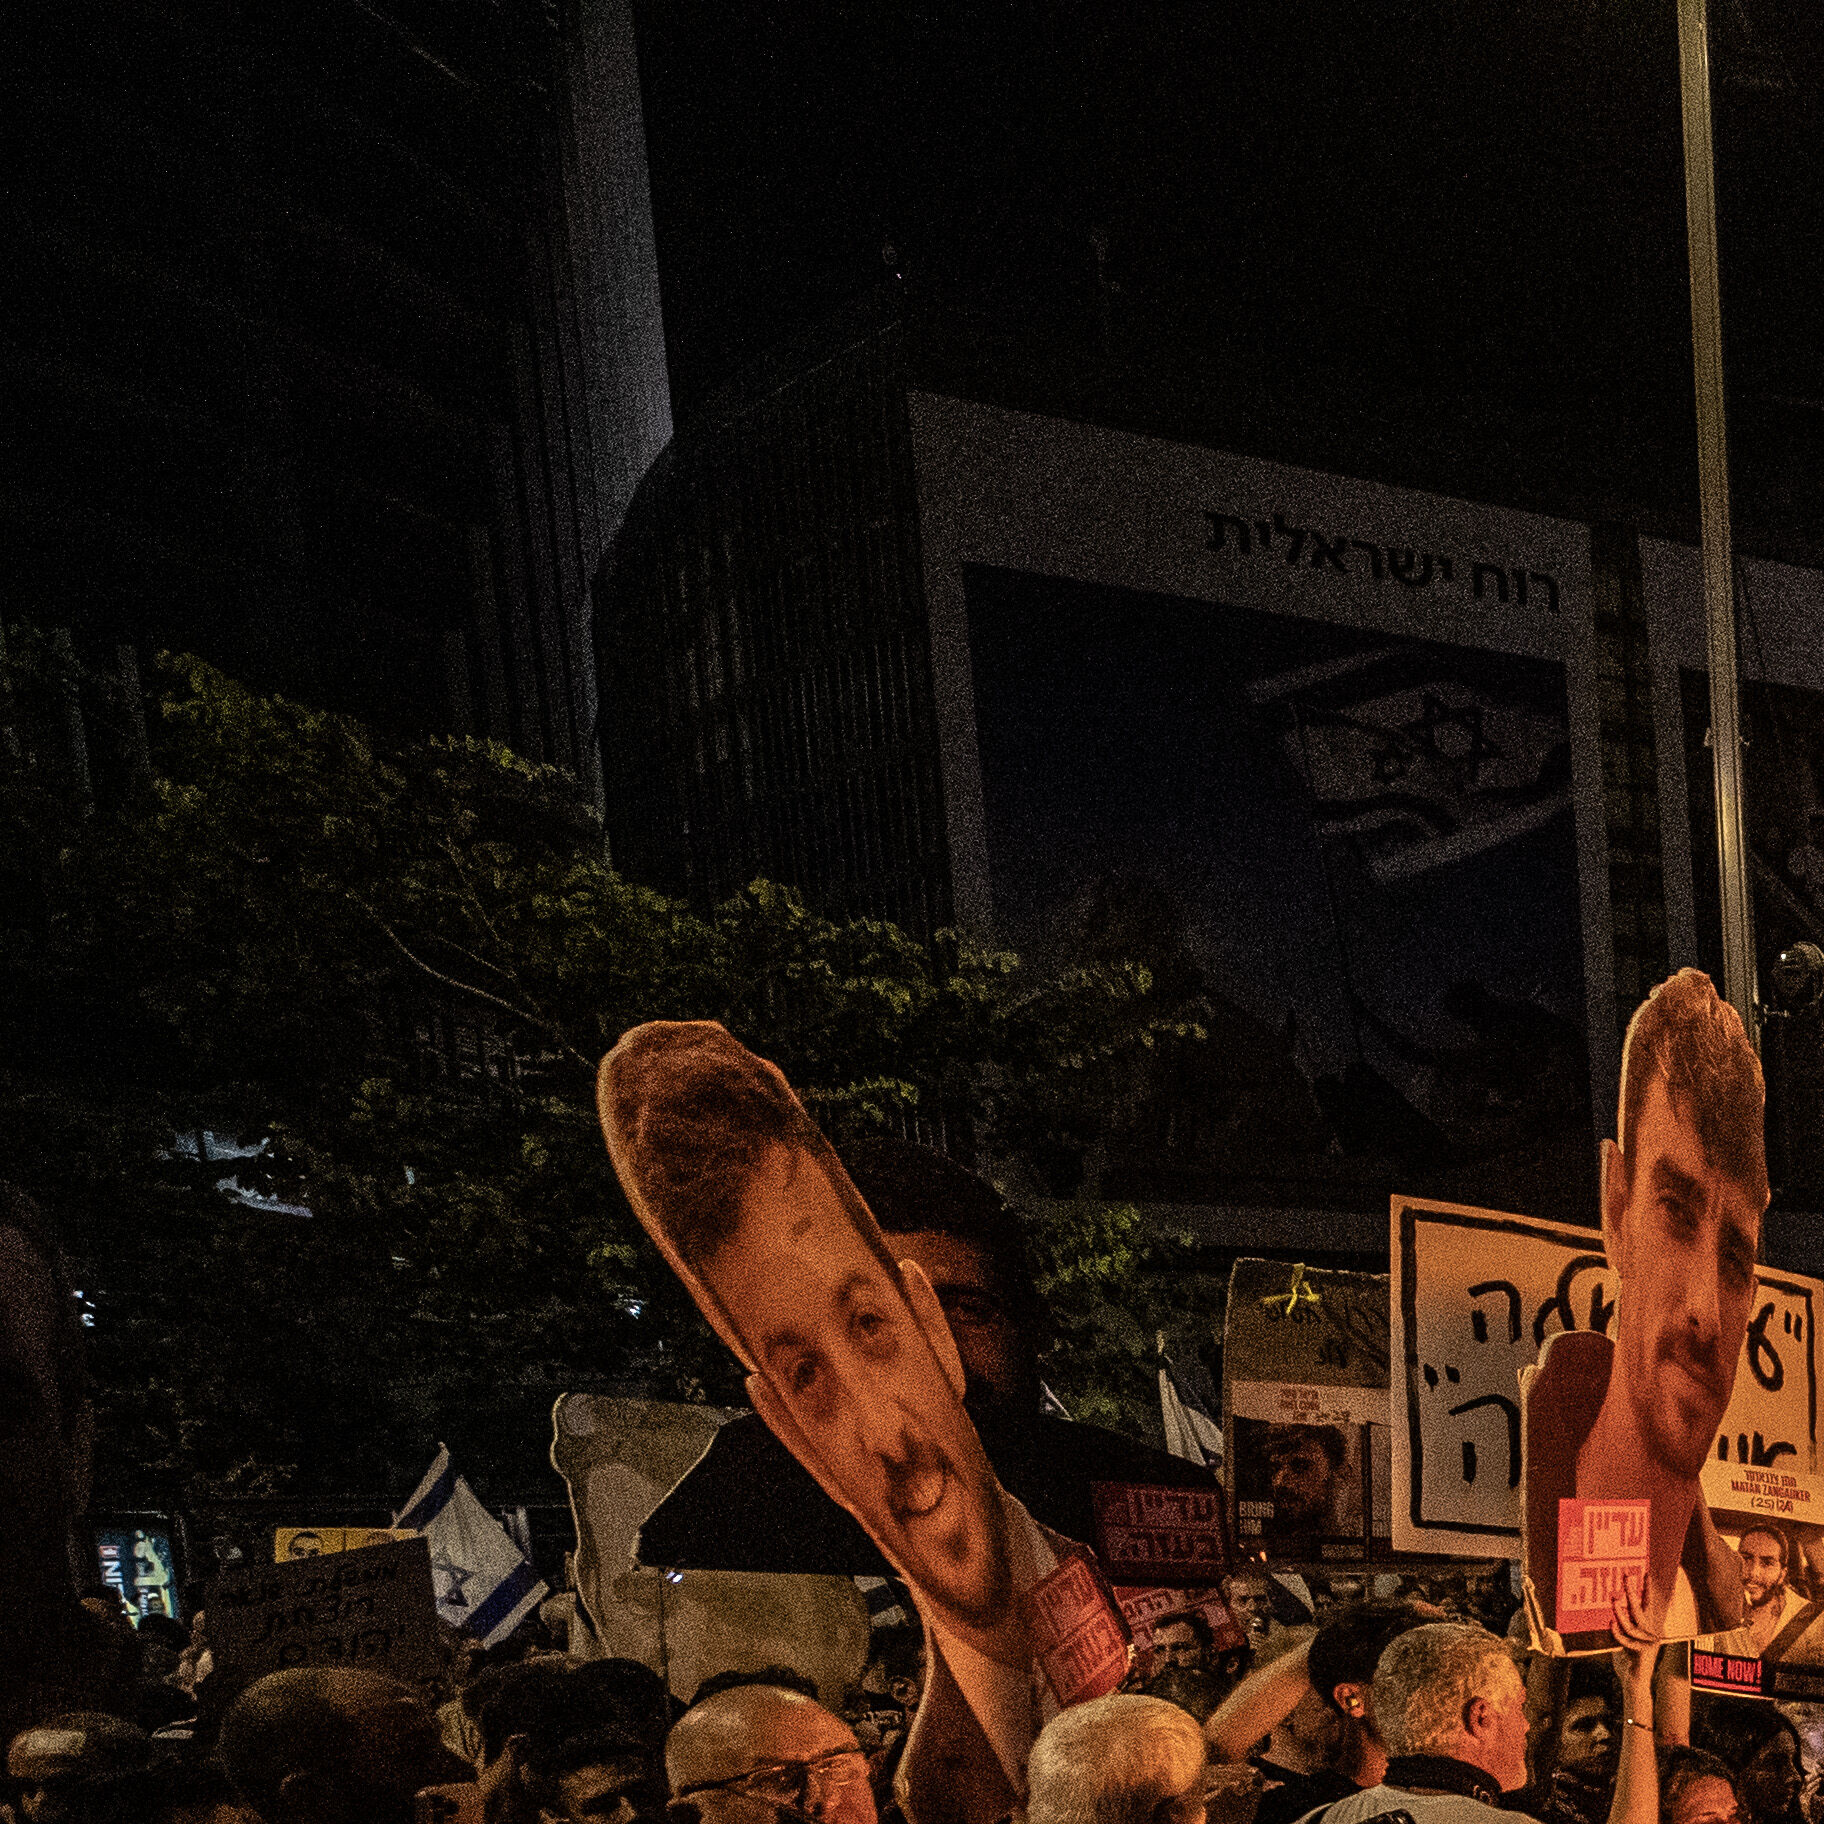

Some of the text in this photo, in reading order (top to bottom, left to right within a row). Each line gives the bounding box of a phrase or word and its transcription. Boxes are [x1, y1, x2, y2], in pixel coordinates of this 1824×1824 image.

[1204, 511, 1561, 613] רוח ישראלית
[1731, 1480, 1761, 1494] MATAN
[1588, 1511, 1645, 1555] עדיין
[1726, 1656, 1763, 1684] NOW!
